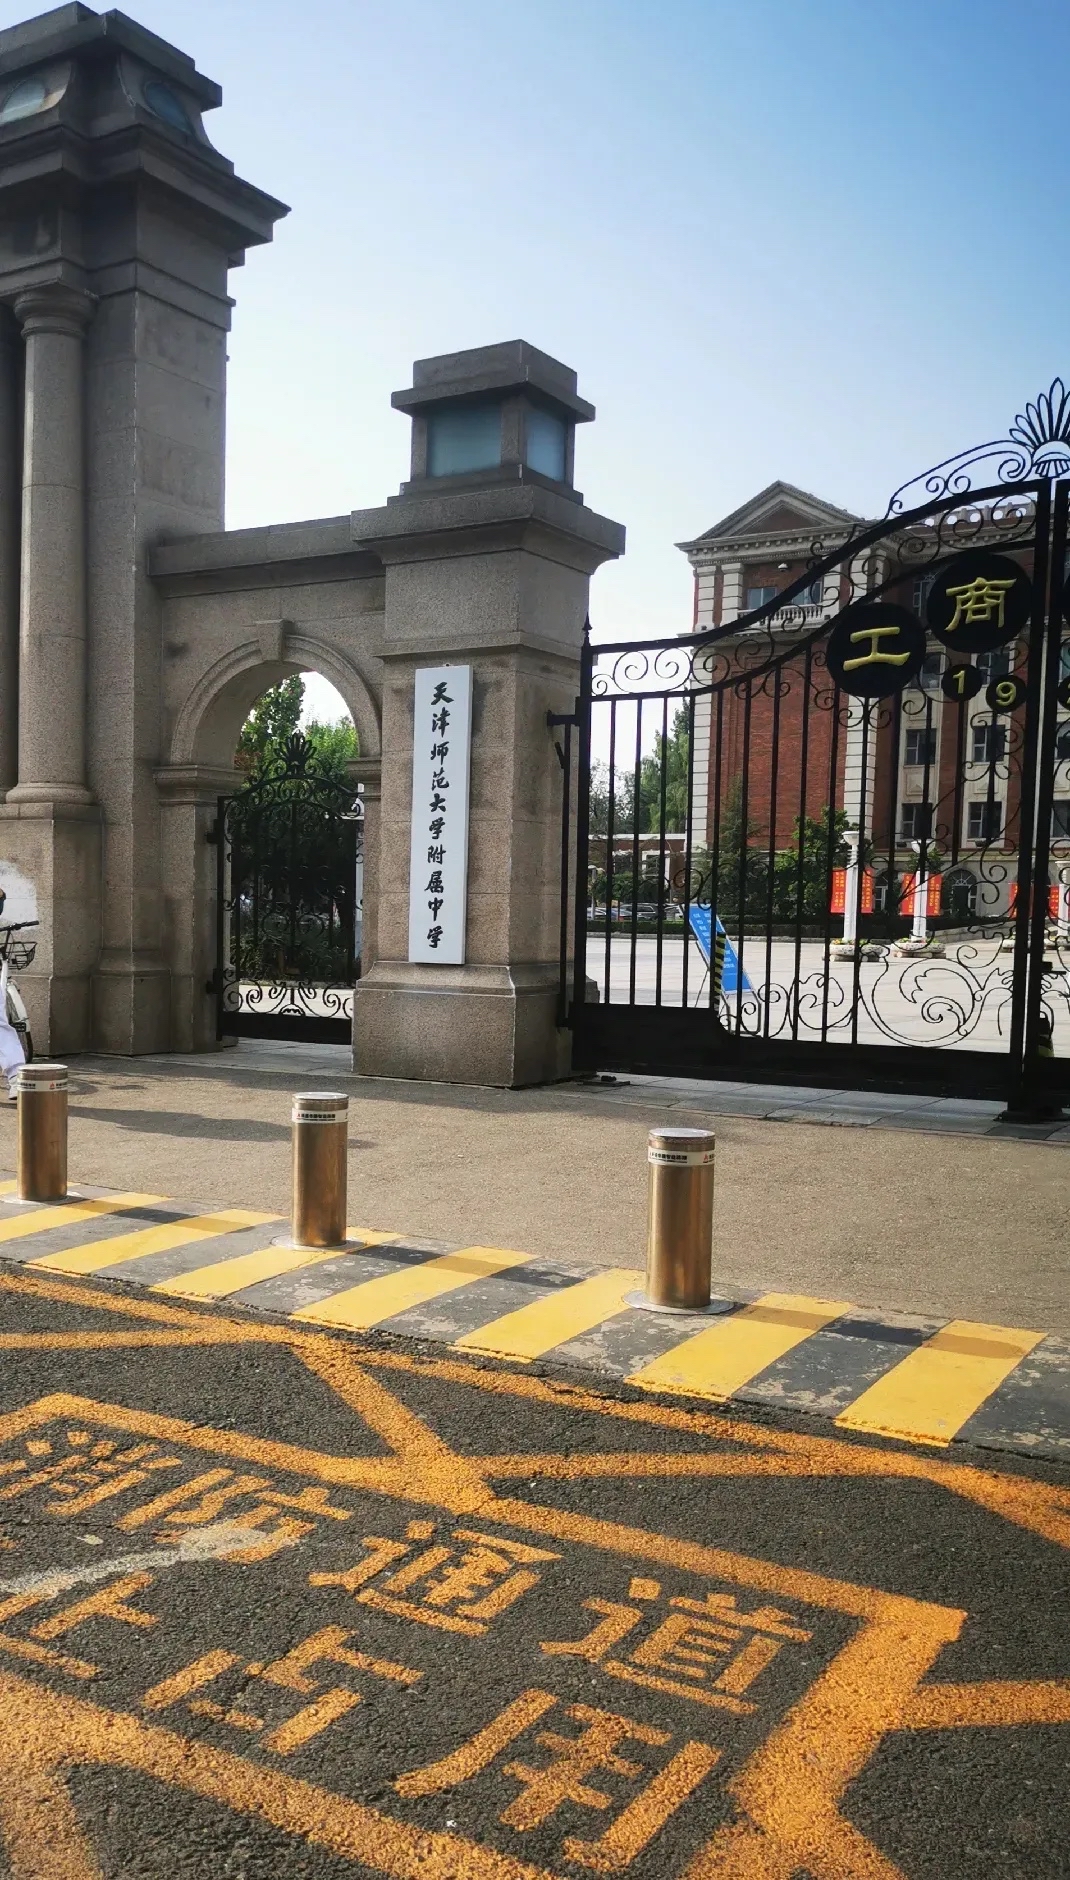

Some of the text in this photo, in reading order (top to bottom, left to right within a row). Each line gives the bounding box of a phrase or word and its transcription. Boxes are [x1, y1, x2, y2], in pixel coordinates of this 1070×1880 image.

[424, 681, 455, 948] 天津师范大学附属中学
[0, 1537, 723, 1872] 止占用
